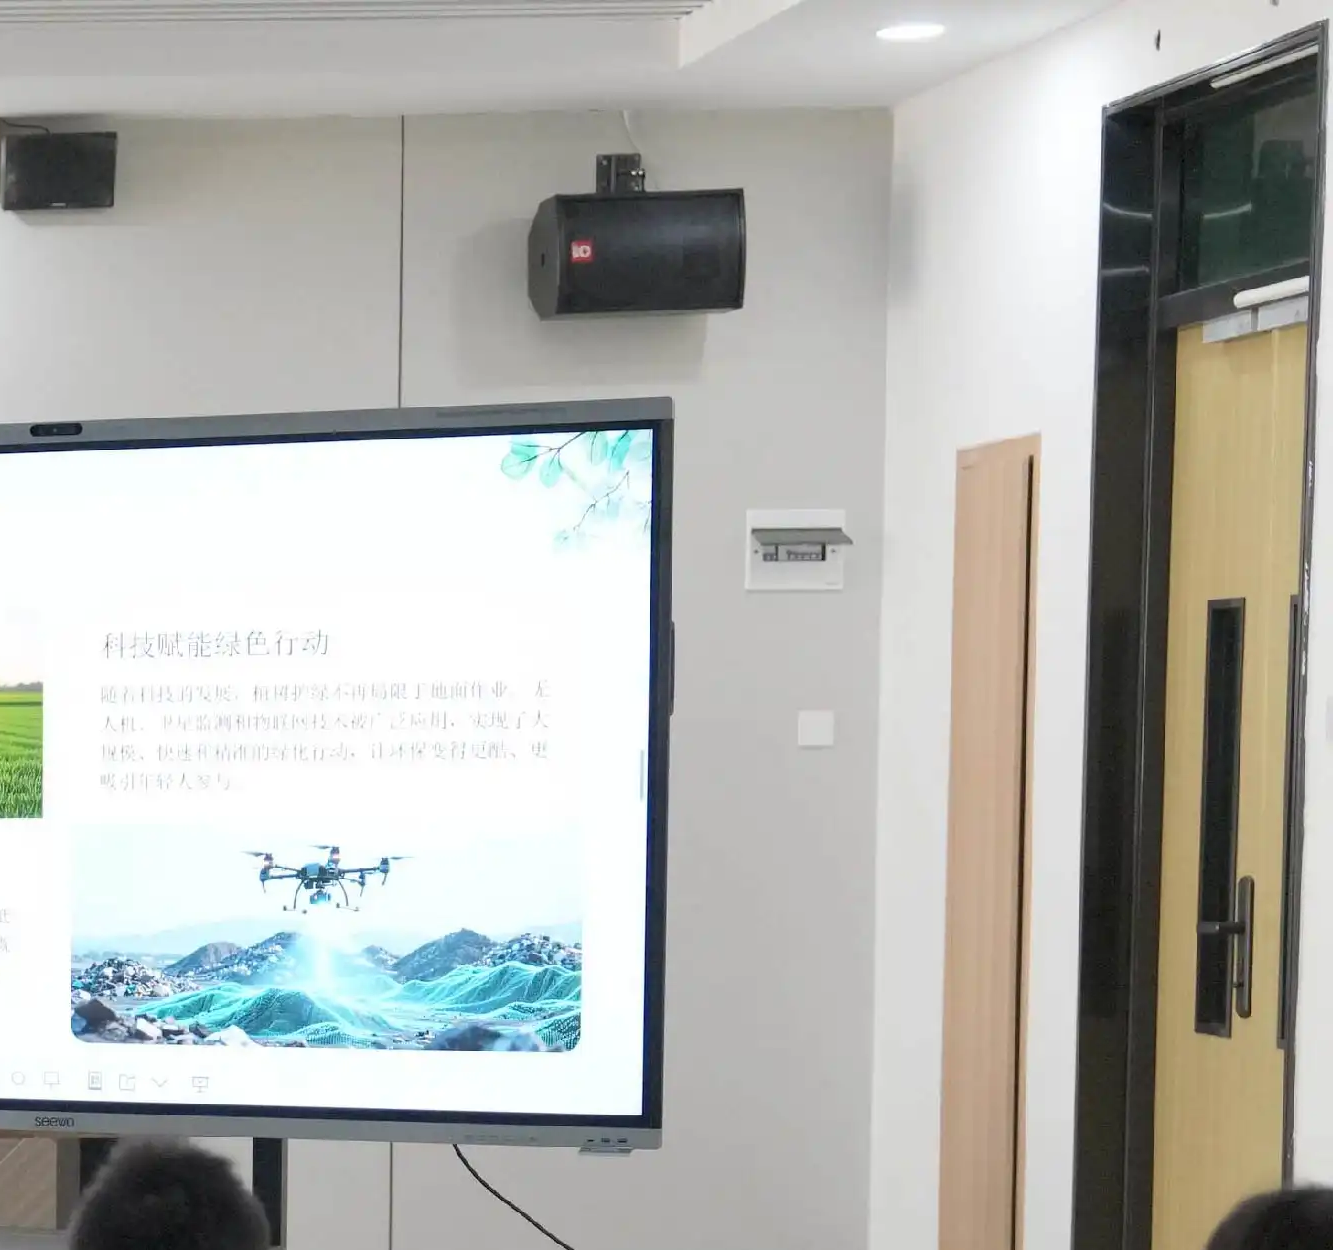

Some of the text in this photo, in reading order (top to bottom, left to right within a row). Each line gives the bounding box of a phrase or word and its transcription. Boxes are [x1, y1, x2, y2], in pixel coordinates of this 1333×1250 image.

[101, 629, 330, 659] 科技赋能绿色行动
